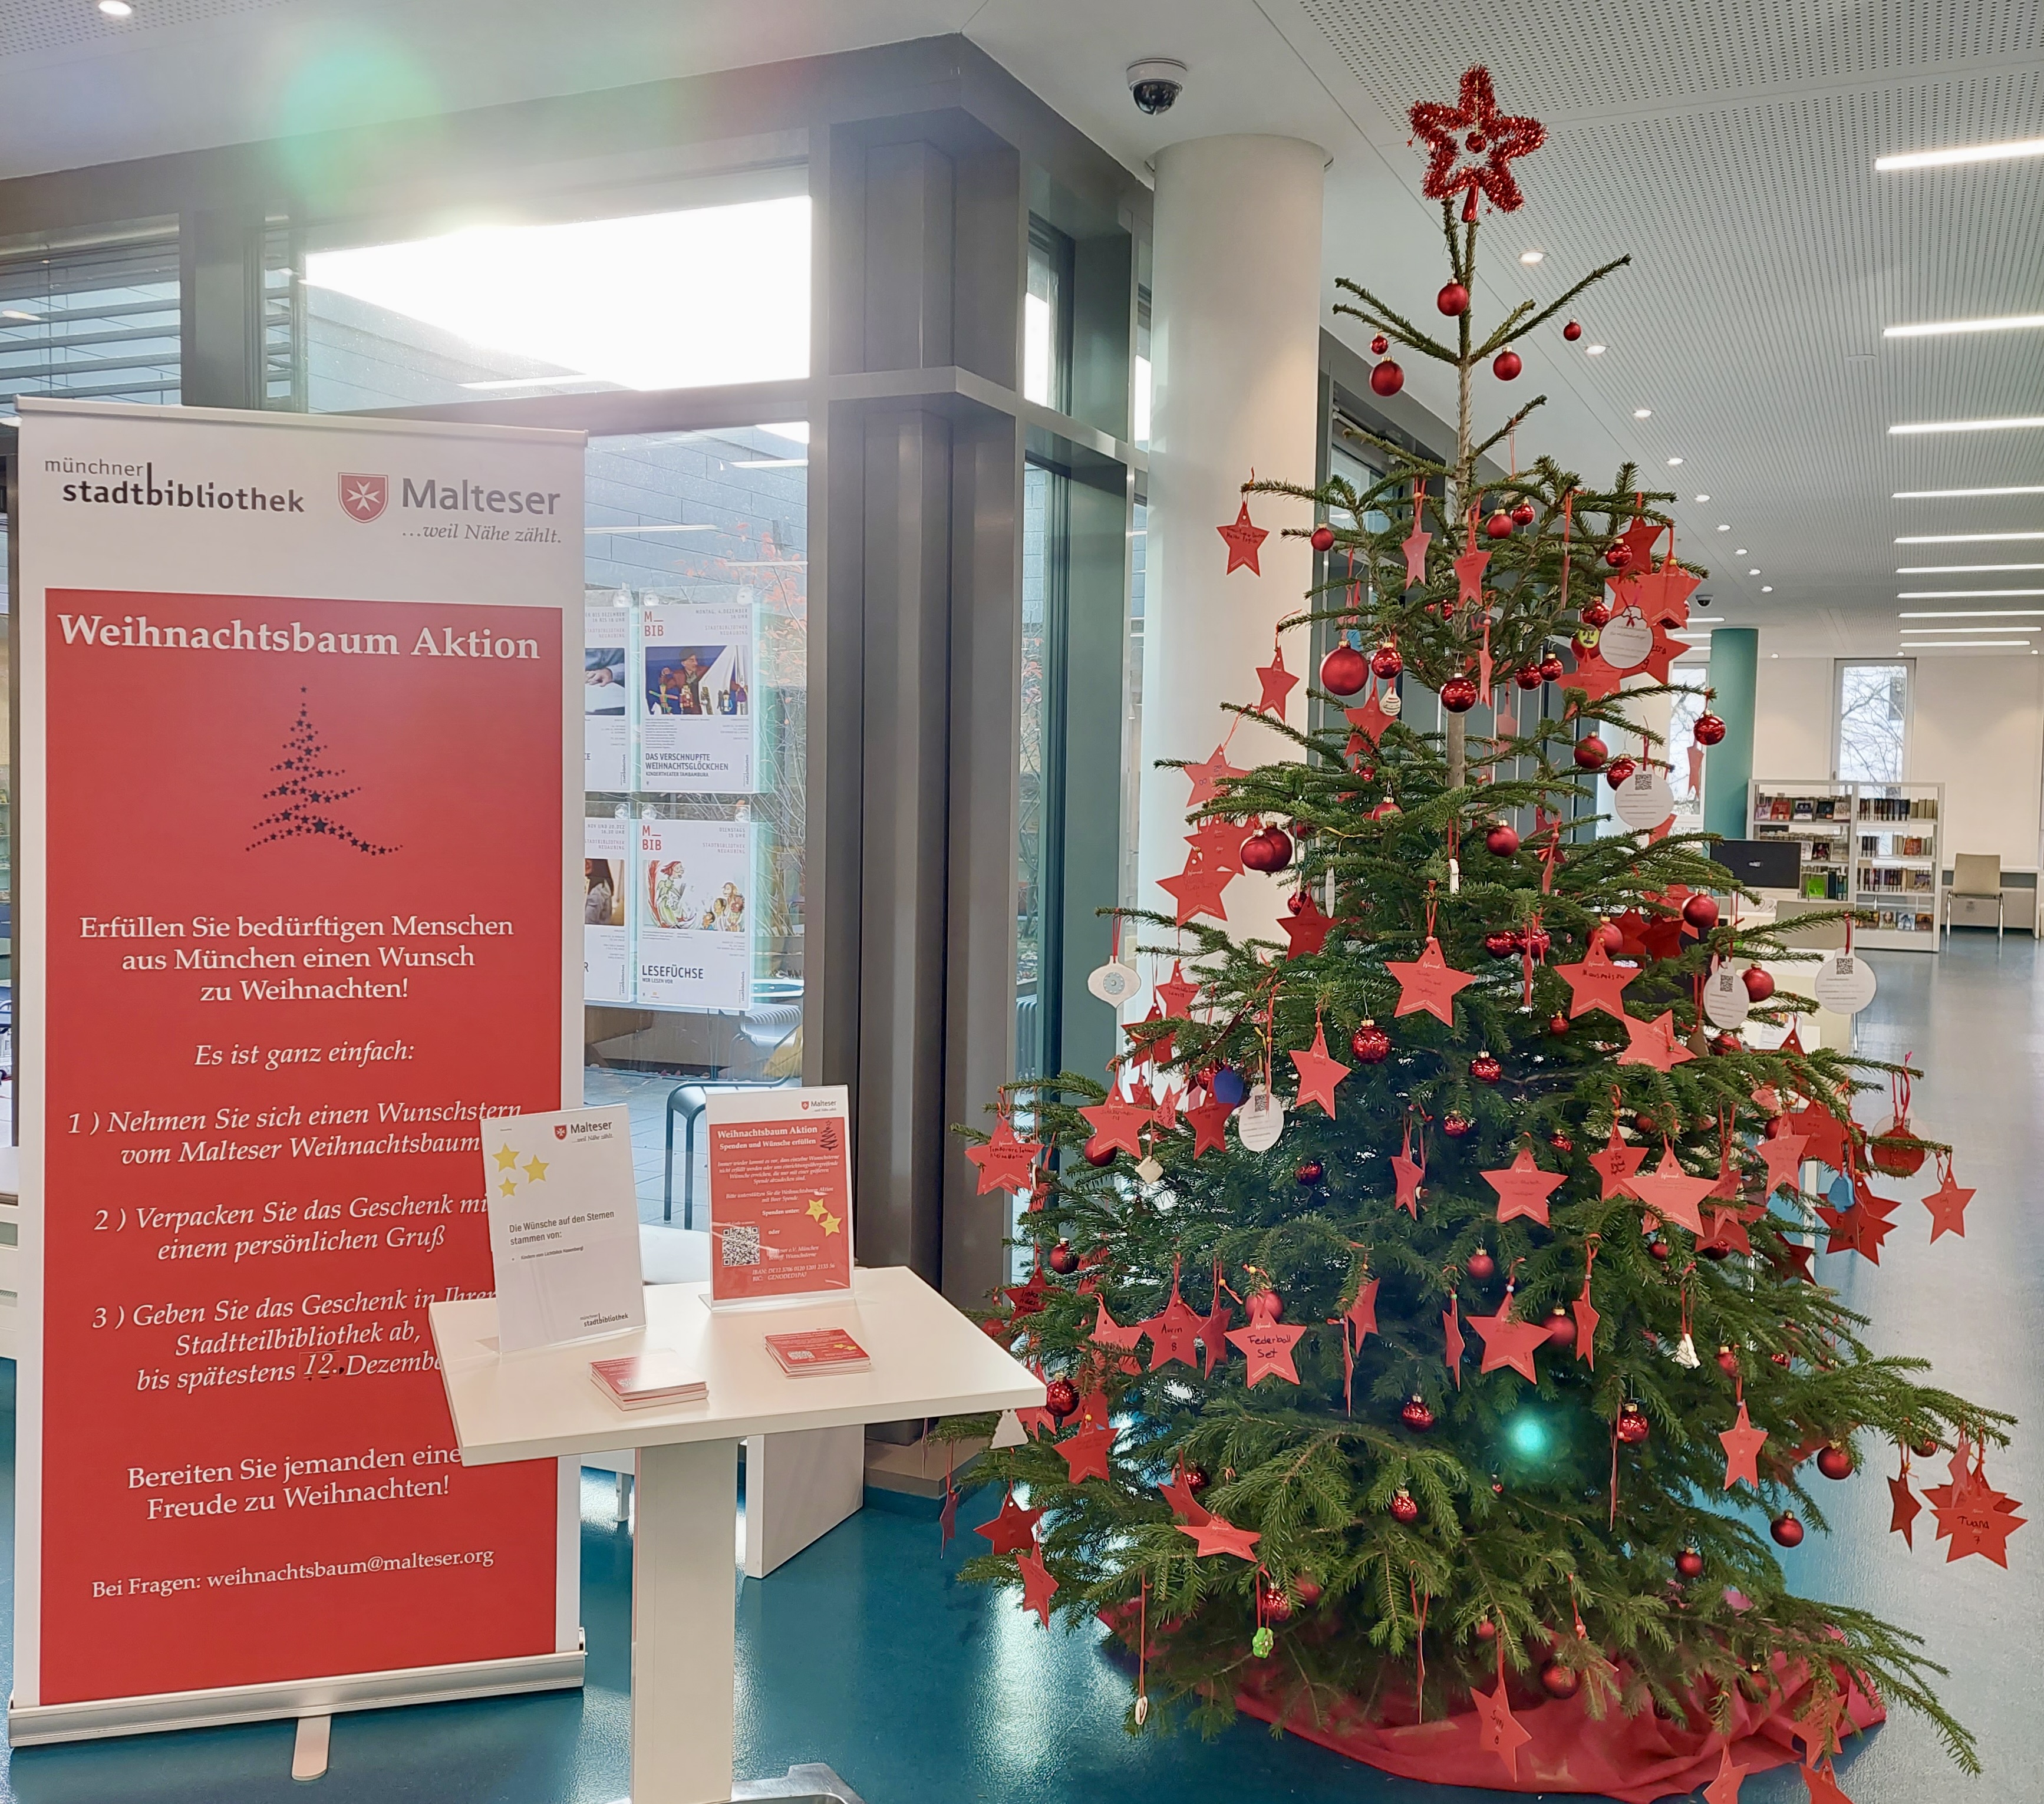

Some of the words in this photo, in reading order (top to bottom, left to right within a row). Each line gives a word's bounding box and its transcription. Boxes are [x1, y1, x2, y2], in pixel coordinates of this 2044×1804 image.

[45, 457, 144, 477] münchner
[62, 463, 305, 513] stadtbibliothek
[403, 478, 561, 515] Malteser
[464, 524, 510, 541] Nähe
[514, 527, 561, 543] zählt.
[57, 614, 400, 655] Weihnachtsbaum
[410, 627, 540, 659] Aktion
[644, 625, 664, 636] BIB
[645, 761, 728, 770] WEIHNACHTSGLÖCKCHEN
[642, 839, 662, 850] BIB
[80, 916, 186, 938] Erfüllen
[192, 916, 230, 937] Sie
[236, 915, 385, 943] bedürftigen
[391, 913, 514, 935] Menschen
[122, 955, 167, 970] aus
[174, 946, 296, 969] München
[303, 948, 371, 968] einen
[377, 945, 475, 967] Wunsch
[642, 964, 704, 979] LESEFÜCHSE
[200, 987, 233, 1001] zu
[239, 977, 408, 1001] Weihnachten!
[194, 1045, 223, 1065] Es
[231, 1044, 260, 1064] ist
[265, 1048, 322, 1070] ganz
[328, 1040, 414, 1068] einfach:
[107, 1110, 206, 1132] Nehmen
[215, 1108, 250, 1129] Sie
[256, 1105, 302, 1127] sich
[308, 1104, 369, 1126] einen
[377, 1100, 522, 1123] Wunschstern
[571, 1122, 612, 1134] Malteser
[717, 1127, 788, 1139] Weihnachtsbaum
[789, 1126, 817, 1134] Aktion
[121, 1148, 171, 1165] vom
[177, 1140, 282, 1162] Malteser
[289, 1132, 480, 1157] Weihnachtsbaum
[720, 1142, 747, 1151] Spenden
[136, 1203, 254, 1234] Verpacken
[263, 1201, 298, 1222] Sie
[304, 1199, 341, 1221] das
[350, 1193, 453, 1218] Geschenk
[460, 1199, 487, 1213] mi
[523, 1219, 557, 1231] Wünsche
[559, 1216, 570, 1225] auf
[572, 1215, 585, 1223] den
[586, 1211, 615, 1221] Sternen
[158, 1238, 227, 1260] einem
[234, 1229, 378, 1263] persönlichen
[386, 1225, 446, 1252] Gruß
[510, 1234, 545, 1245] stammen
[133, 1303, 206, 1326] Geben
[214, 1300, 249, 1321] Sie
[256, 1297, 294, 1318] das
[302, 1289, 408, 1315] Geschenk
[414, 1288, 435, 1307] in
[583, 1312, 629, 1327] stadtbibliothek
[175, 1321, 384, 1356] Stadtteilbibliothek
[389, 1320, 420, 1343] ab,
[1172, 1341, 1177, 1351] 8
[1248, 1335, 1291, 1344] Federball
[1258, 1348, 1277, 1358] Set
[137, 1368, 170, 1391] bis
[177, 1364, 295, 1394] spätestens
[345, 1350, 441, 1376] Dezembe
[127, 1464, 233, 1489] Bereiten
[240, 1458, 277, 1480] Sie
[282, 1448, 406, 1483] jemanden
[412, 1444, 461, 1466] eine
[147, 1493, 237, 1520] Freude
[244, 1495, 276, 1512] zu
[282, 1475, 449, 1508] Weihnachten!
[1957, 1516, 1989, 1529] Tuana
[1974, 1536, 1980, 1544] 7
[92, 1579, 123, 1598] Bei
[128, 1578, 201, 1597] Fragen:
[206, 1551, 494, 1587] weihnachtsbaum@malteser.org
